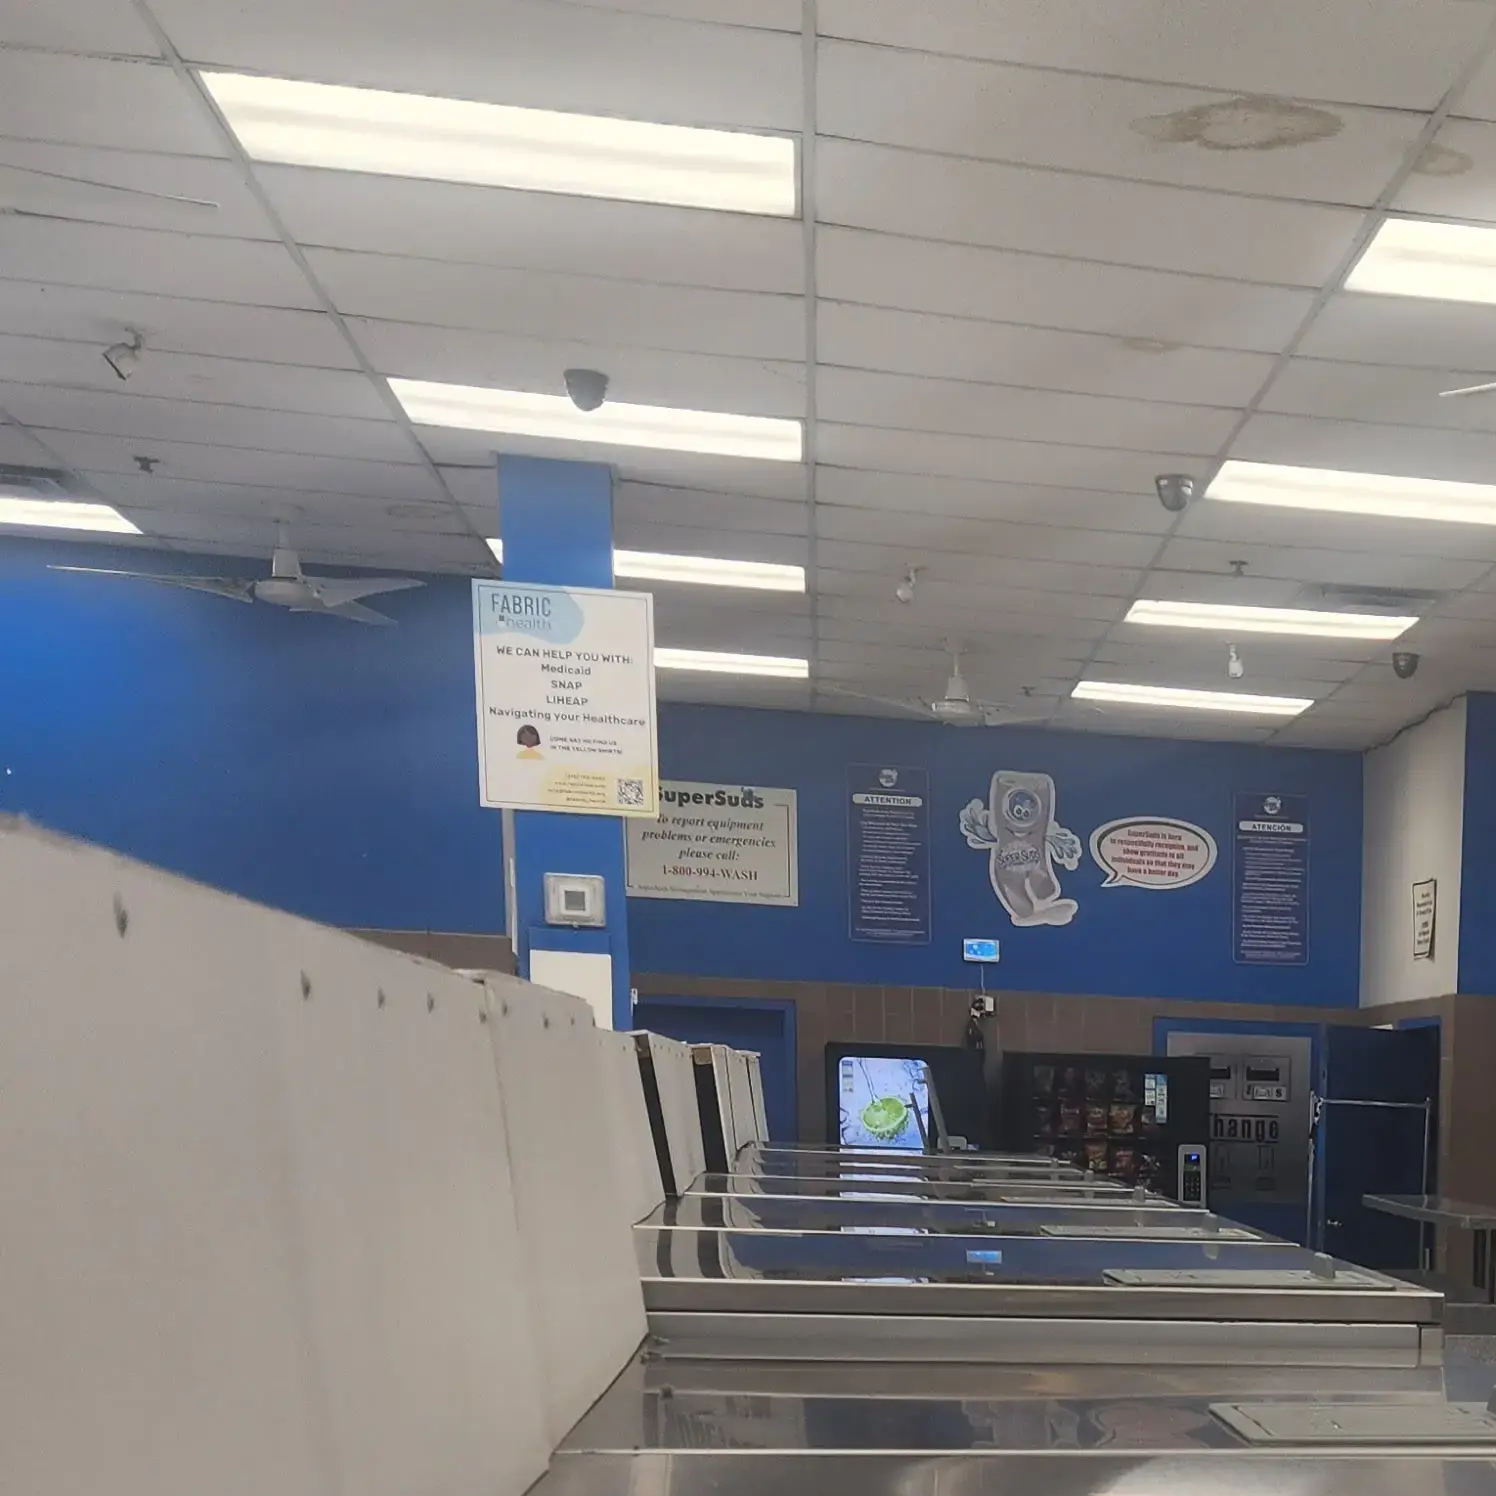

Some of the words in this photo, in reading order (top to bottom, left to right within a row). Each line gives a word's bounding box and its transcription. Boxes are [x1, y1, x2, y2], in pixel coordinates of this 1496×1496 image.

[491, 593, 551, 617] FABRIC
[506, 616, 552, 630] health
[496, 646, 513, 655] WE
[516, 647, 540, 657] CAN
[543, 649, 572, 660] HELP
[575, 651, 599, 662] YOU
[602, 653, 634, 664] WITH:
[541, 663, 591, 676] Medicaid
[551, 680, 582, 690] SNAP
[546, 695, 588, 706] LIHEAP
[489, 706, 551, 721] Navigating
[554, 712, 579, 722] your
[583, 713, 646, 726] Healthcare
[864, 796, 912, 805] ATTENTION
[657, 814, 669, 824] To
[671, 816, 705, 827] report
[707, 819, 764, 831] equipment
[1251, 822, 1292, 832] ATENCIÓN
[642, 830, 692, 841] problems
[710, 835, 776, 848] emergencies
[679, 847, 713, 859] please
[716, 849, 740, 861] call:
[662, 864, 758, 881] 1-800-994-WASH
[1213, 1113, 1280, 1143] hange
